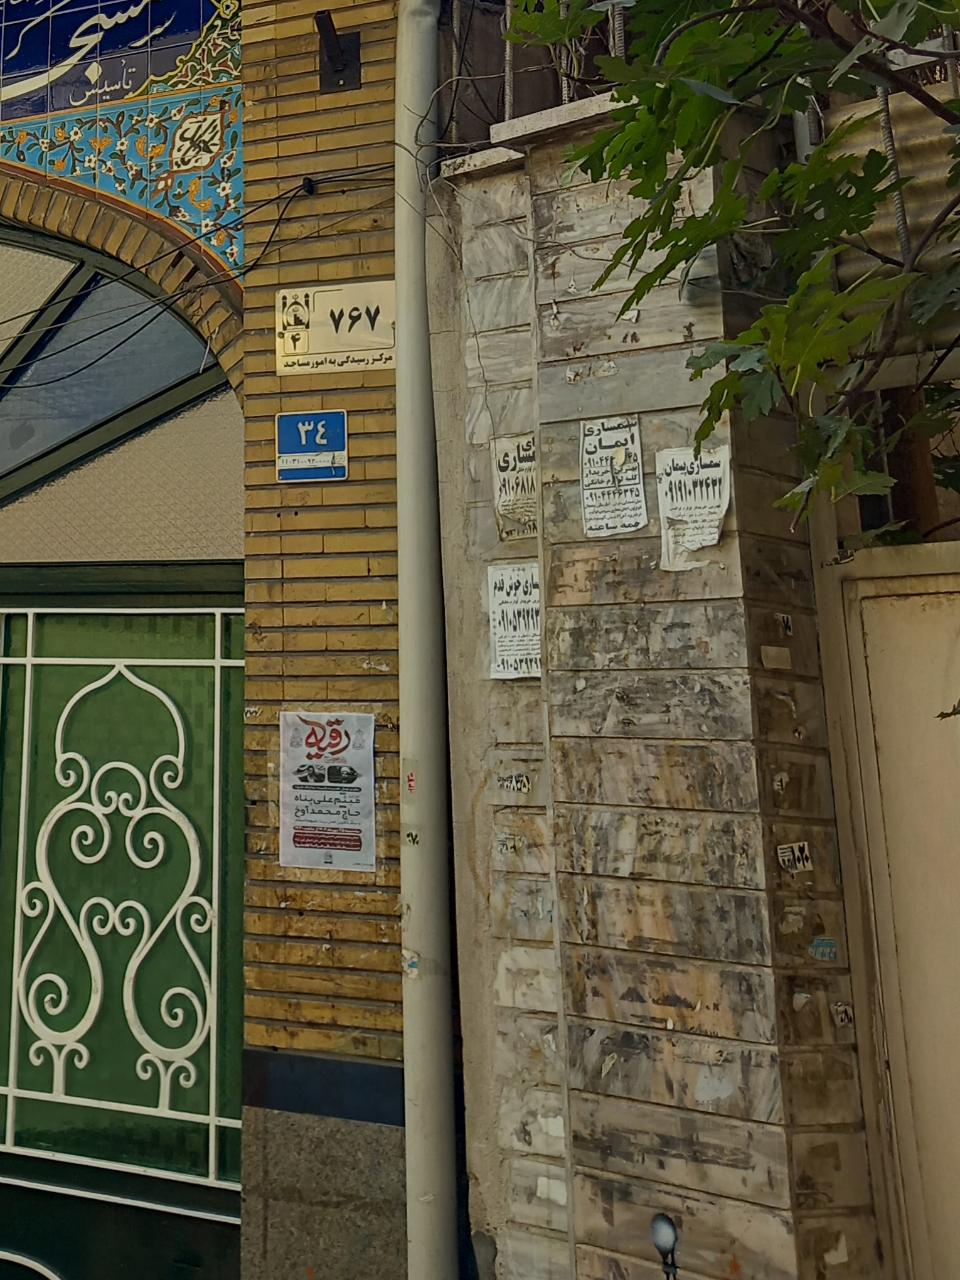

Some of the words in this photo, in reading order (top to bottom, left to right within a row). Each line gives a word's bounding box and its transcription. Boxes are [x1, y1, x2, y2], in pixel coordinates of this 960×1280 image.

[329, 304, 381, 334] ۷۶۷
[290, 332, 301, 351] ۴
[283, 358, 311, 370] مساجد
[310, 357, 328, 368] امور
[328, 357, 337, 366] به
[337, 355, 370, 367] رسیدگی
[371, 353, 393, 365] مرکز
[585, 433, 635, 456] ایمان
